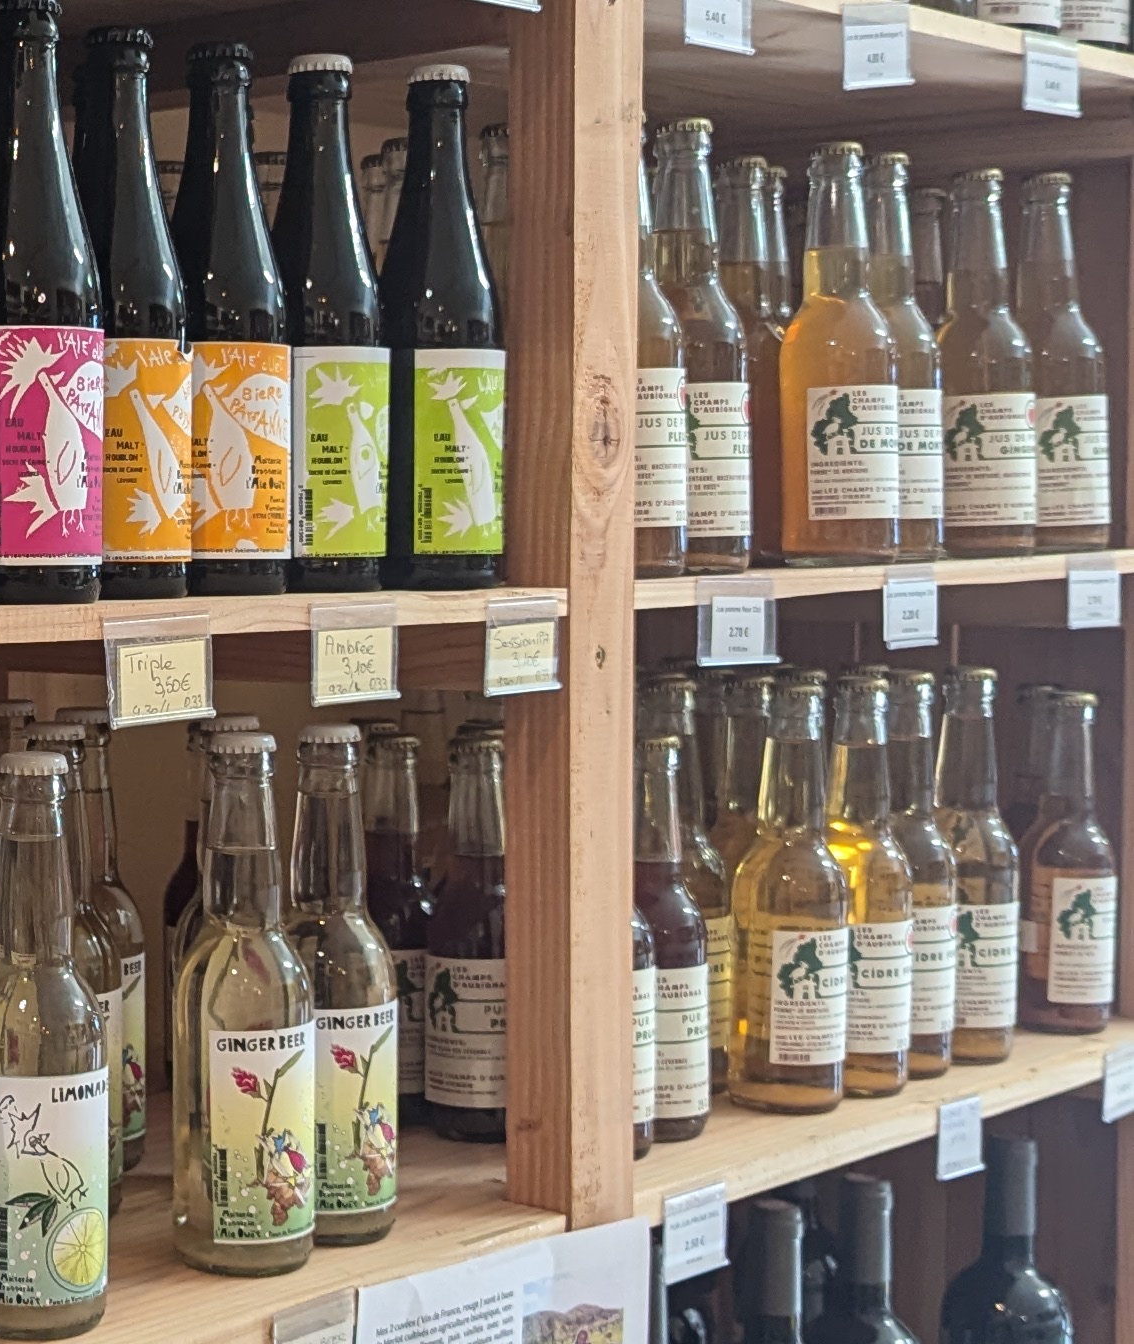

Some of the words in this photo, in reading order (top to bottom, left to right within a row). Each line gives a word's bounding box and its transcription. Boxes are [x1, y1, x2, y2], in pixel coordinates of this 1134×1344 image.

[704, 431, 726, 441] JUS
[861, 426, 881, 436] JUS
[860, 439, 877, 448] DE
[325, 634, 375, 656] Ambrée
[124, 652, 176, 679] Triple
[316, 1013, 371, 1031] GINGER
[373, 1008, 395, 1027] BEER
[682, 1014, 701, 1025] PUR
[216, 1036, 275, 1053] GINGER
[279, 1031, 305, 1050] BEER
